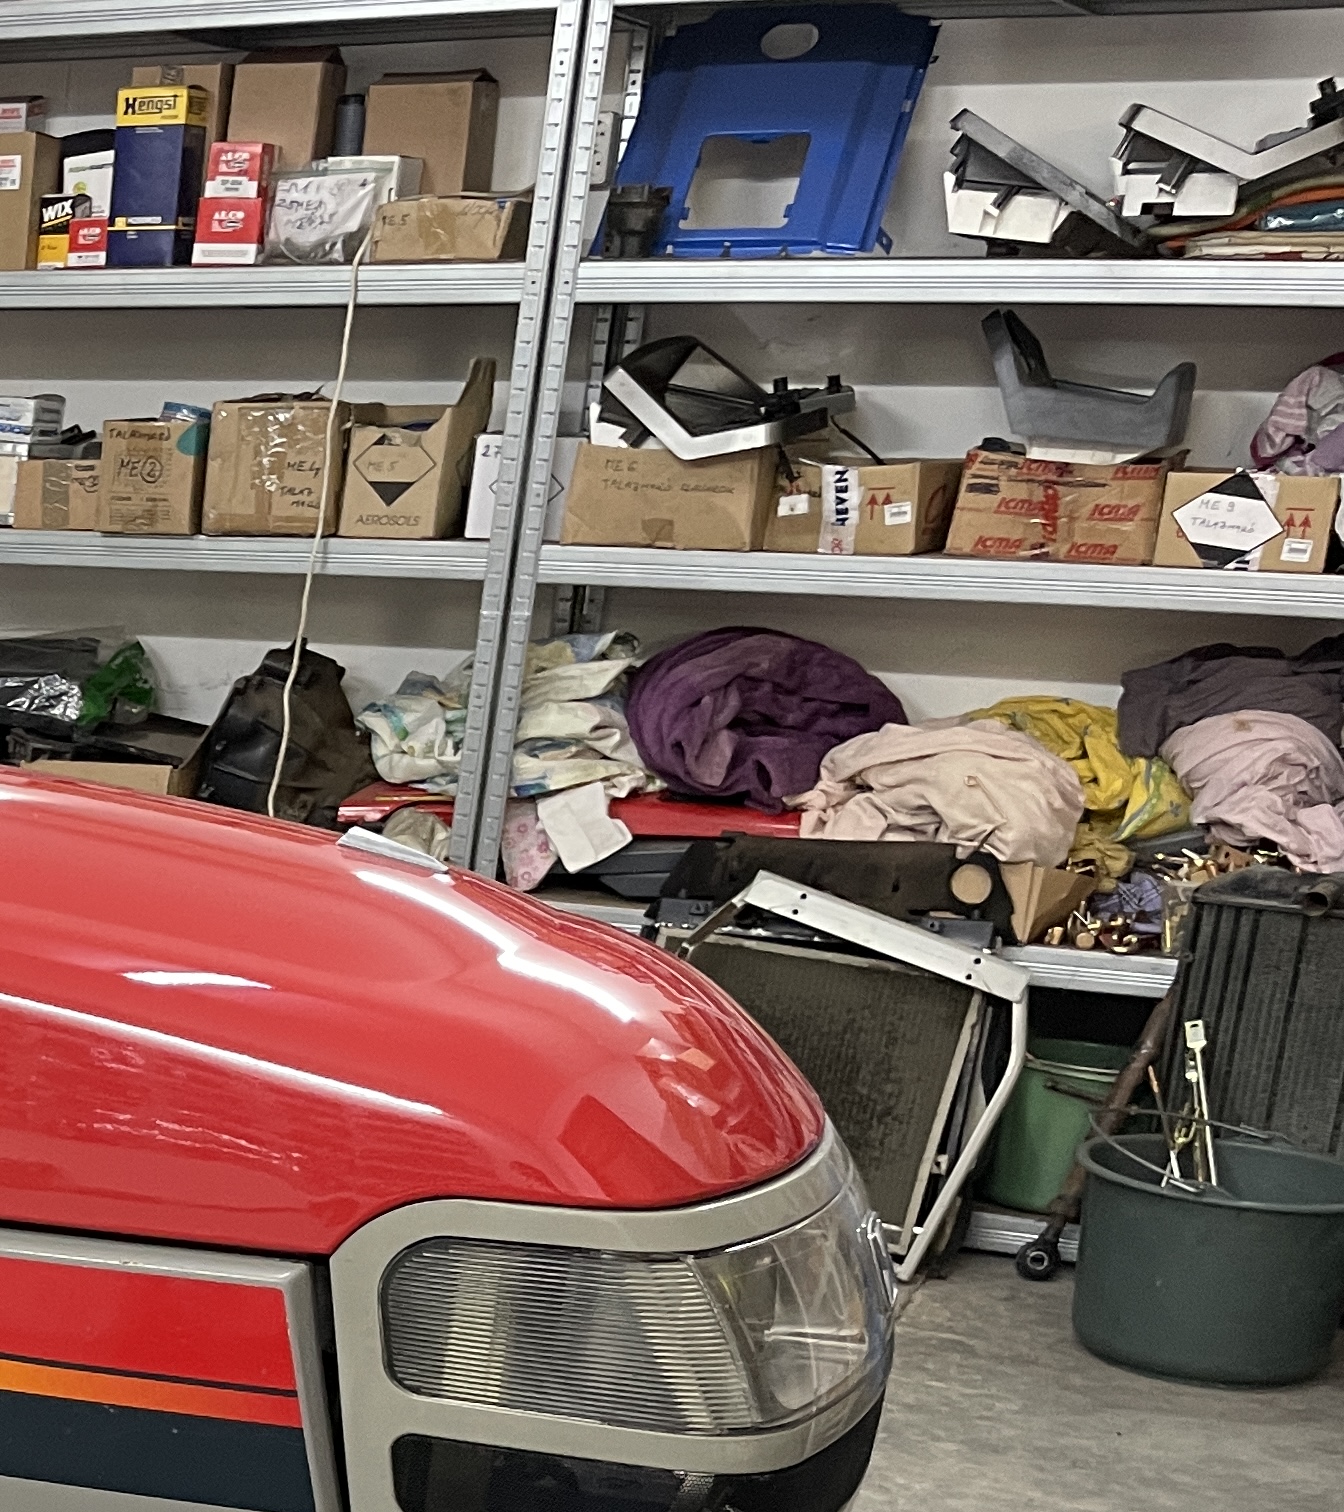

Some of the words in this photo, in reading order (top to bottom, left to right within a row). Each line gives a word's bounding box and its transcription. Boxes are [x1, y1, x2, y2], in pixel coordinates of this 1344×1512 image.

[42, 199, 74, 223] WIX
[1199, 498, 1222, 511] ME
[356, 514, 421, 527] AEROSOLS
